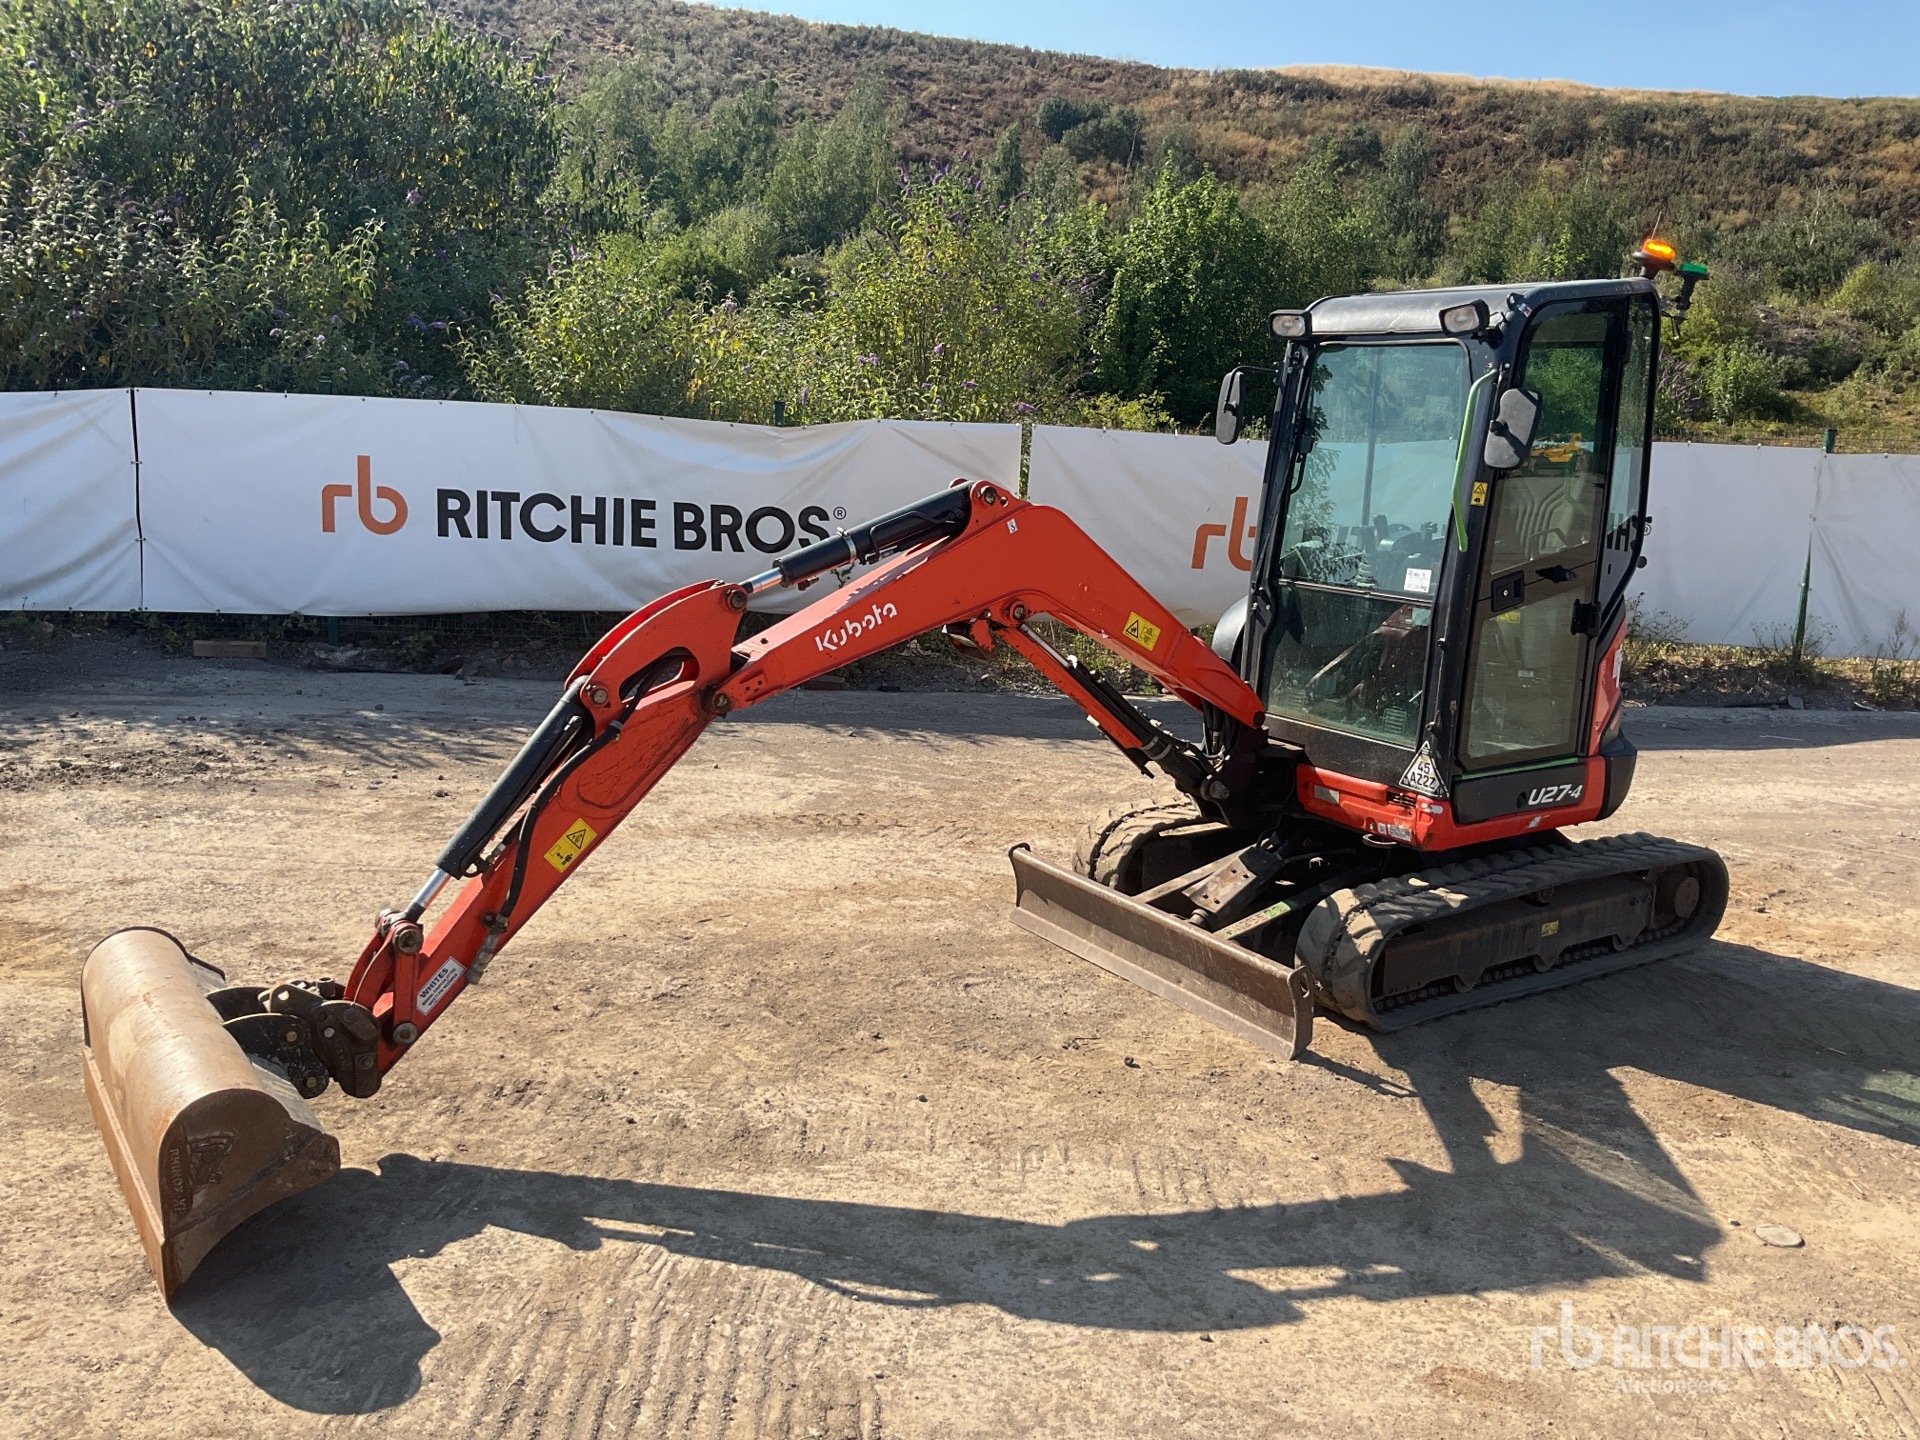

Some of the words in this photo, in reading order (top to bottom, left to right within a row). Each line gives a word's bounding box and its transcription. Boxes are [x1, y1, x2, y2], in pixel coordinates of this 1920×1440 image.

[321, 454, 409, 536] rb
[436, 487, 658, 549] RITCHIE
[814, 602, 898, 652] Kubota
[1417, 760, 1431, 775] 45
[1527, 783, 1584, 806] U27-4
[419, 967, 449, 998] WHITES
